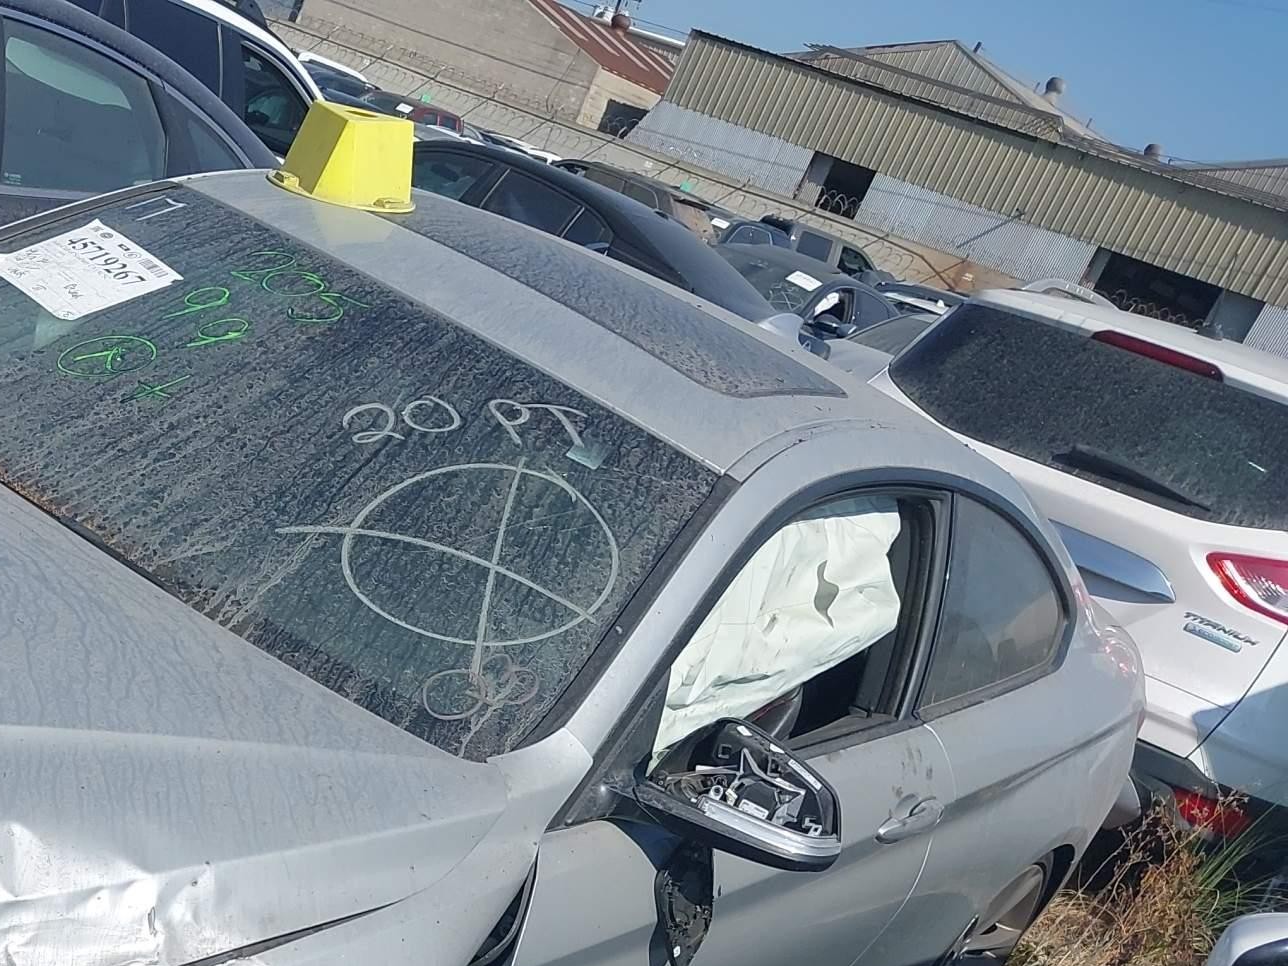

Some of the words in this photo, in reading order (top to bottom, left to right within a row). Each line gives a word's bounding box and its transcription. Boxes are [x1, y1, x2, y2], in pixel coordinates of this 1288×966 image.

[68, 237, 147, 287] 45719267
[230, 250, 375, 323] 205
[342, 395, 461, 444] 20
[1183, 611, 1261, 647] TITANIUM
